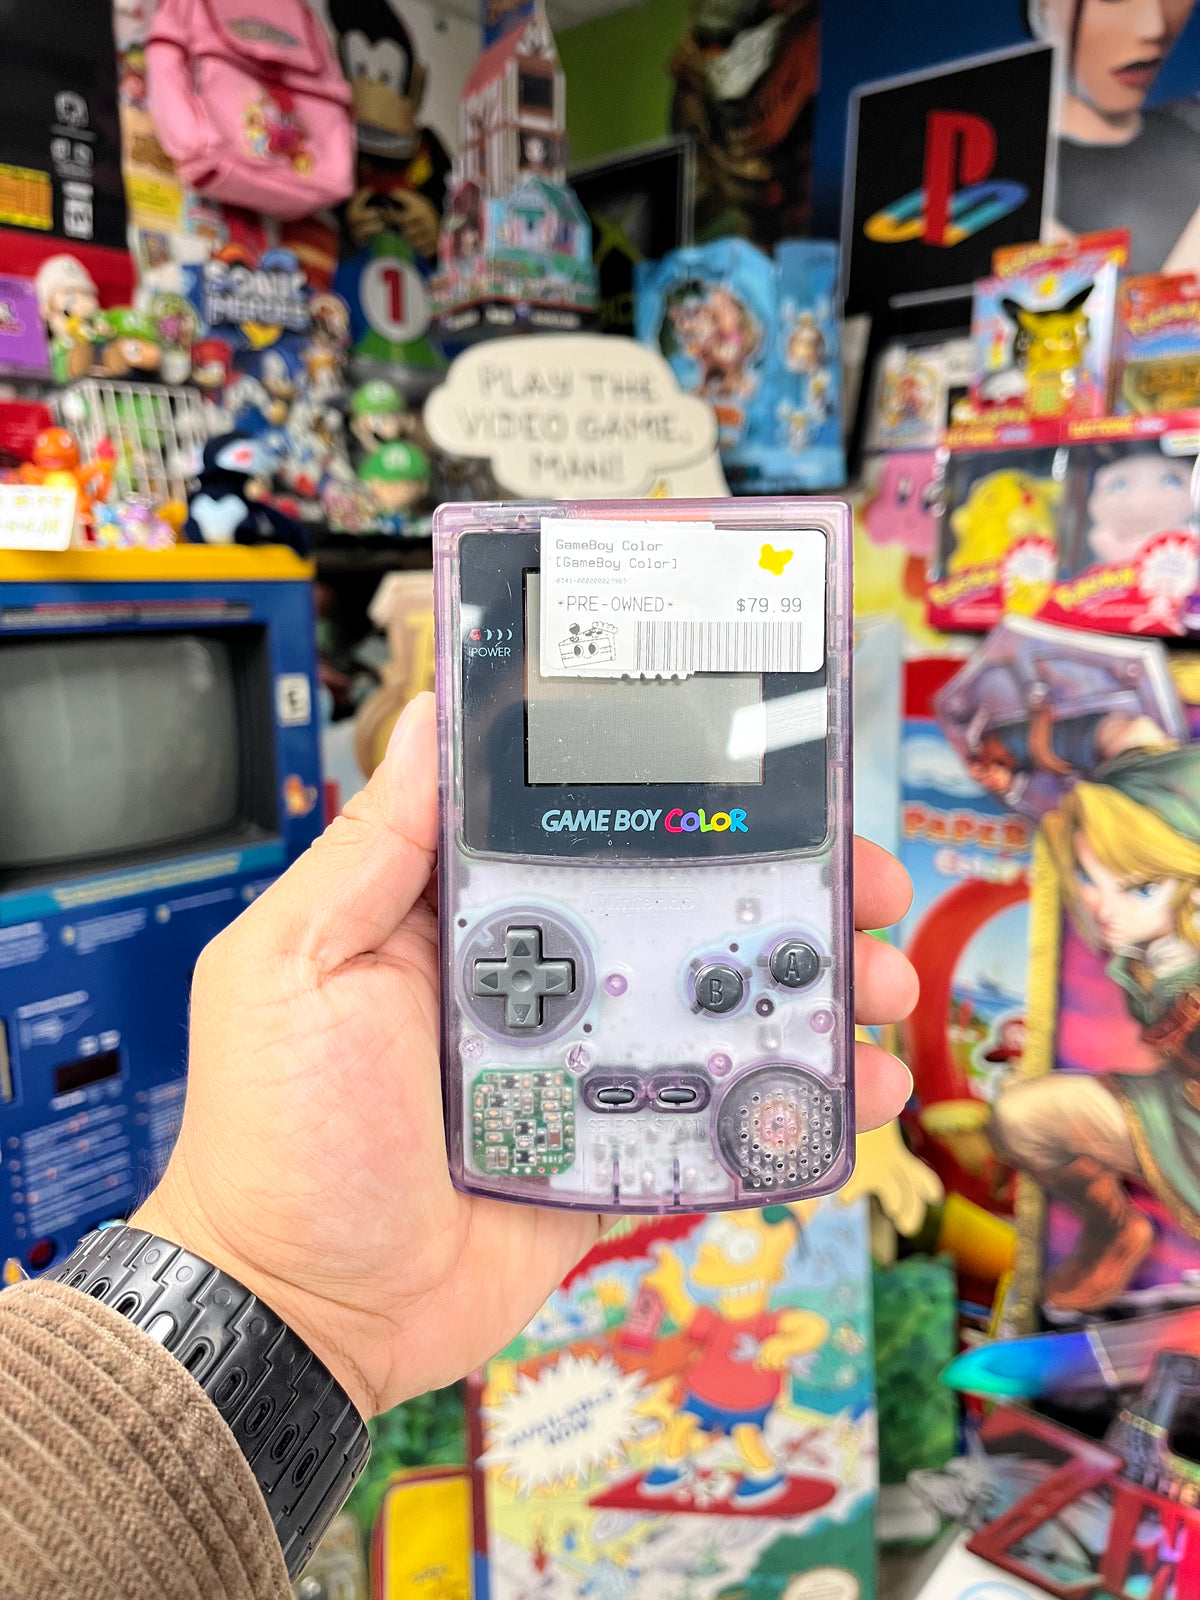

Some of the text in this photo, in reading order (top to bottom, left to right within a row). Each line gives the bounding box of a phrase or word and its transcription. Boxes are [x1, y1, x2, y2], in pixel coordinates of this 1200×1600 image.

[477, 361, 661, 402] PLAY THE
[456, 406, 570, 443] VIDEO
[555, 539, 663, 553] GameBoy Color
[556, 556, 678, 571] [GameBoy Color]
[736, 597, 802, 613] $79.99
[471, 647, 511, 657] POWER
[541, 807, 749, 833] GAME BOY COLOR
[784, 952, 801, 981] A
[709, 978, 723, 1006] B
